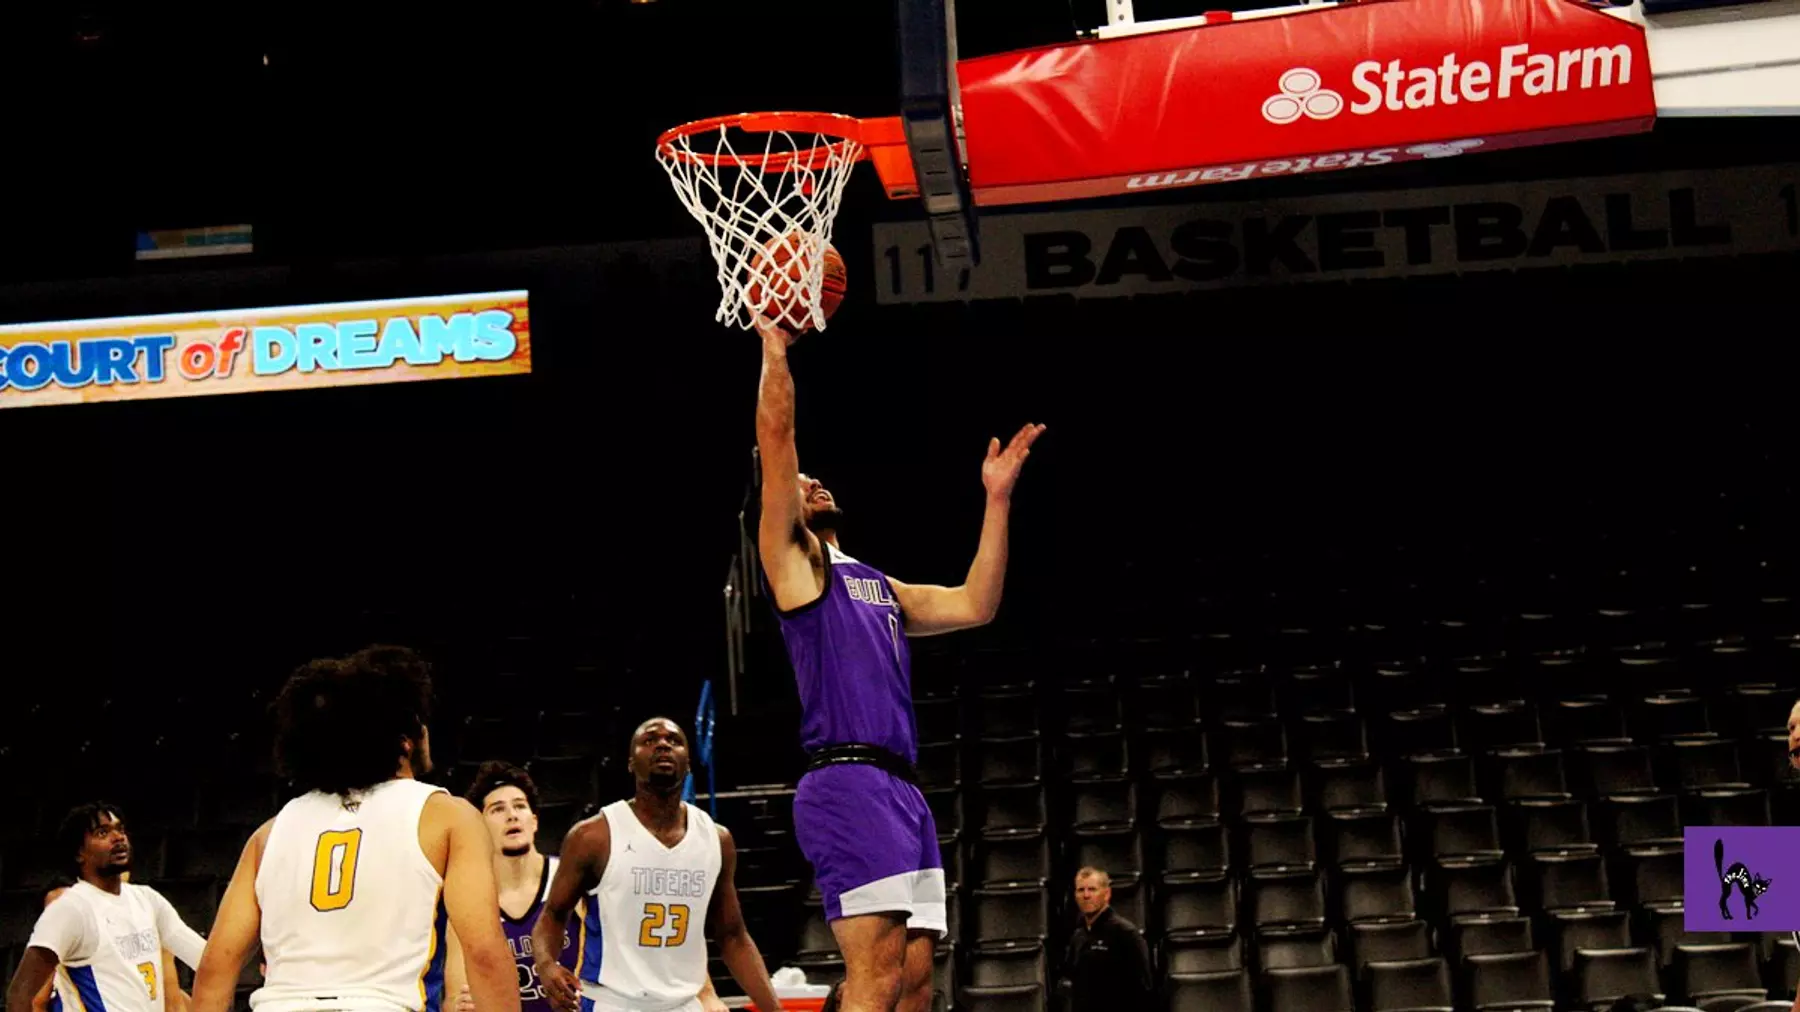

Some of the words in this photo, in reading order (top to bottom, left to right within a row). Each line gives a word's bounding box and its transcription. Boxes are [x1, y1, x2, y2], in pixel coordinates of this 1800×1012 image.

[1023, 188, 1730, 290] BASKETBALL
[0, 335, 175, 391] OURT
[178, 326, 247, 381] of
[252, 308, 518, 376] DREAMS
[310, 827, 363, 912] 0
[631, 866, 706, 898] TIGERS
[638, 902, 691, 948] 23
